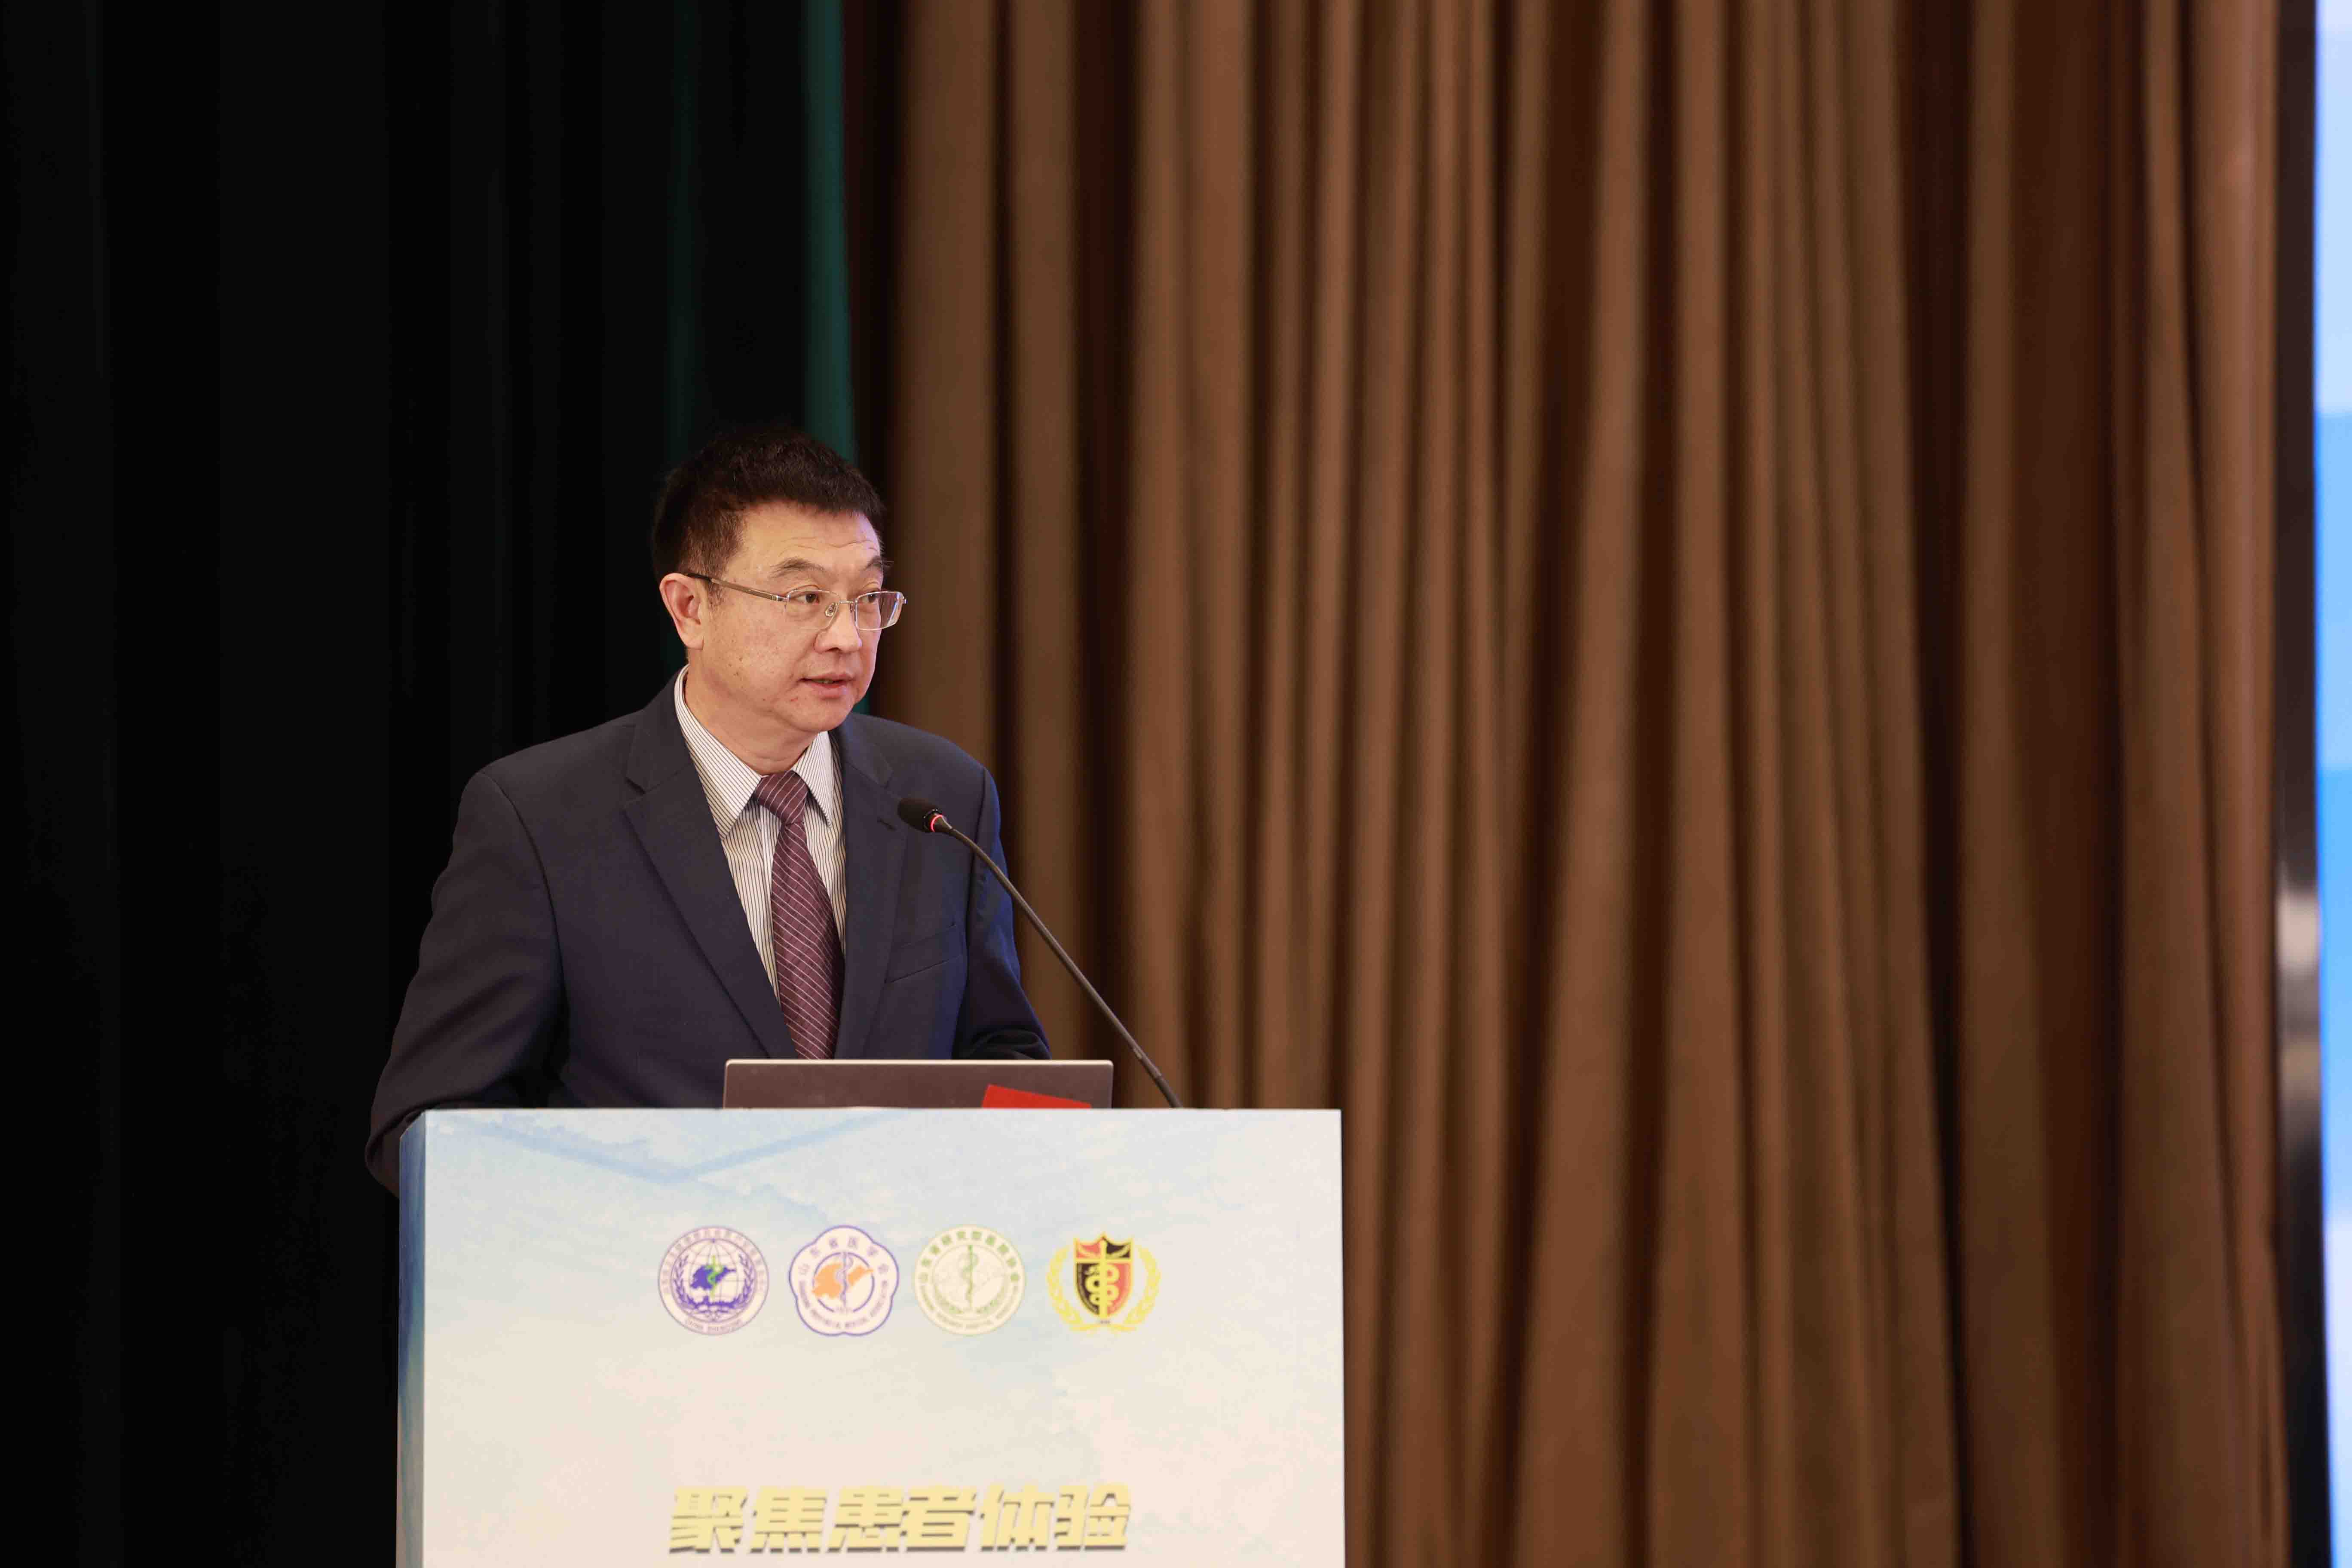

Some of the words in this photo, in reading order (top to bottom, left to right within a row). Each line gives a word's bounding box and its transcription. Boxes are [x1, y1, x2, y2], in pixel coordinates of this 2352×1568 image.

[670, 1485, 1131, 1553] 聚焦患者体验
